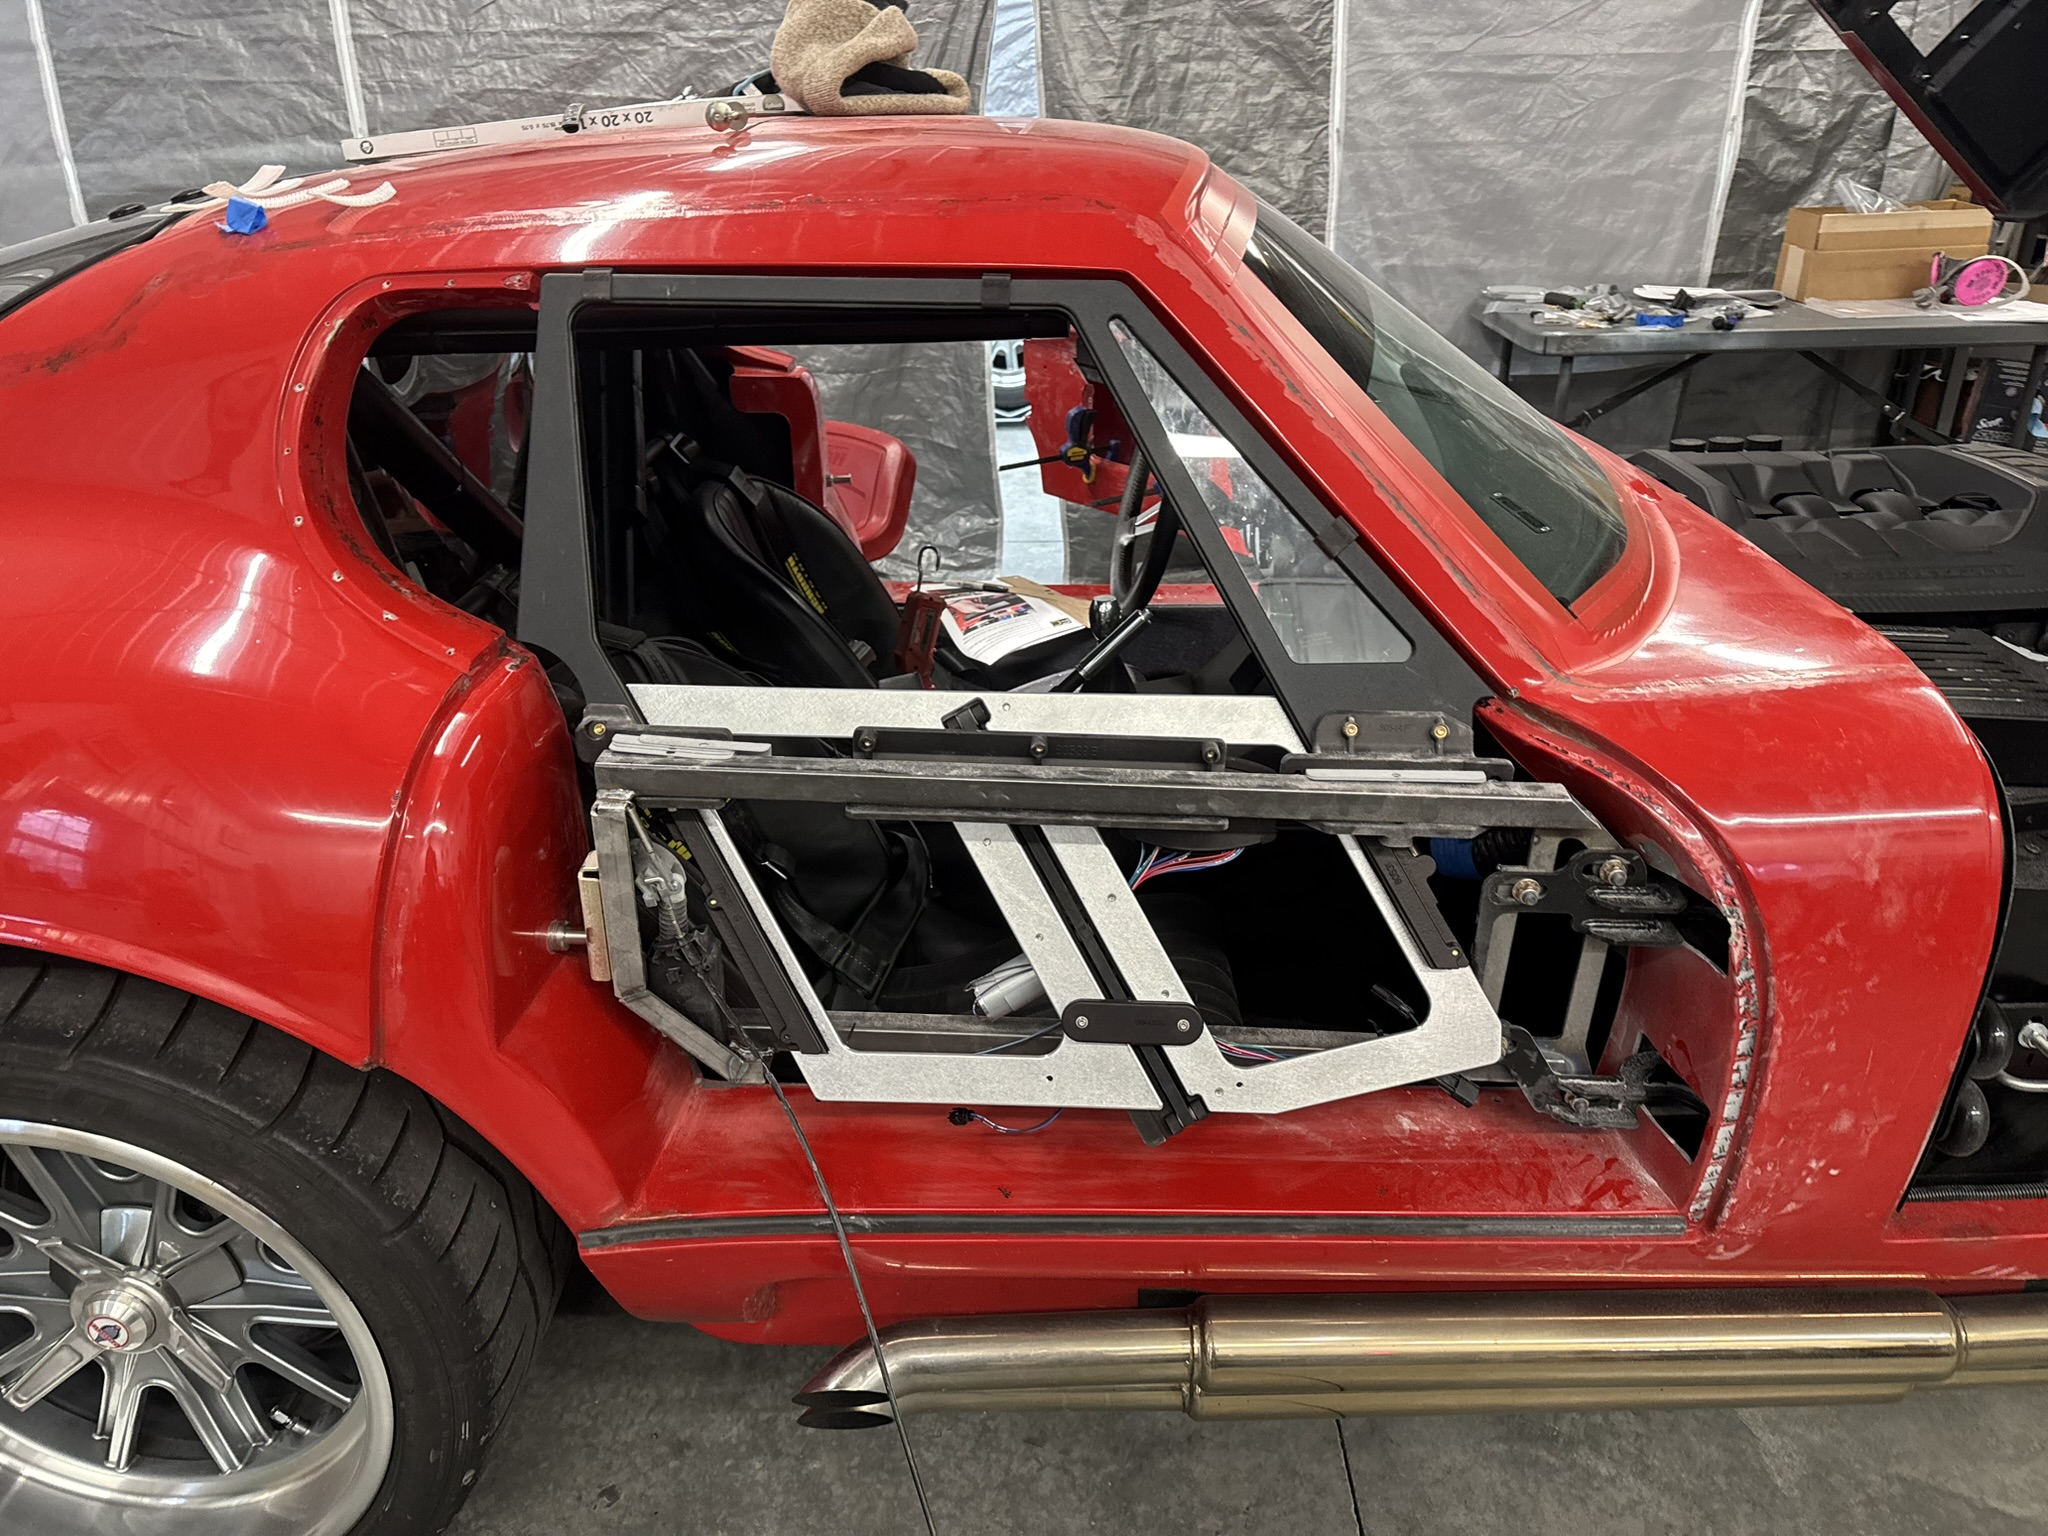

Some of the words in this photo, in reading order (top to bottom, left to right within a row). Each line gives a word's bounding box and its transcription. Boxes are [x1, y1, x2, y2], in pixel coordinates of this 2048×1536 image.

[589, 116, 598, 126] x
[601, 114, 620, 127] 20
[622, 113, 631, 122] x
[635, 111, 653, 124] 20
